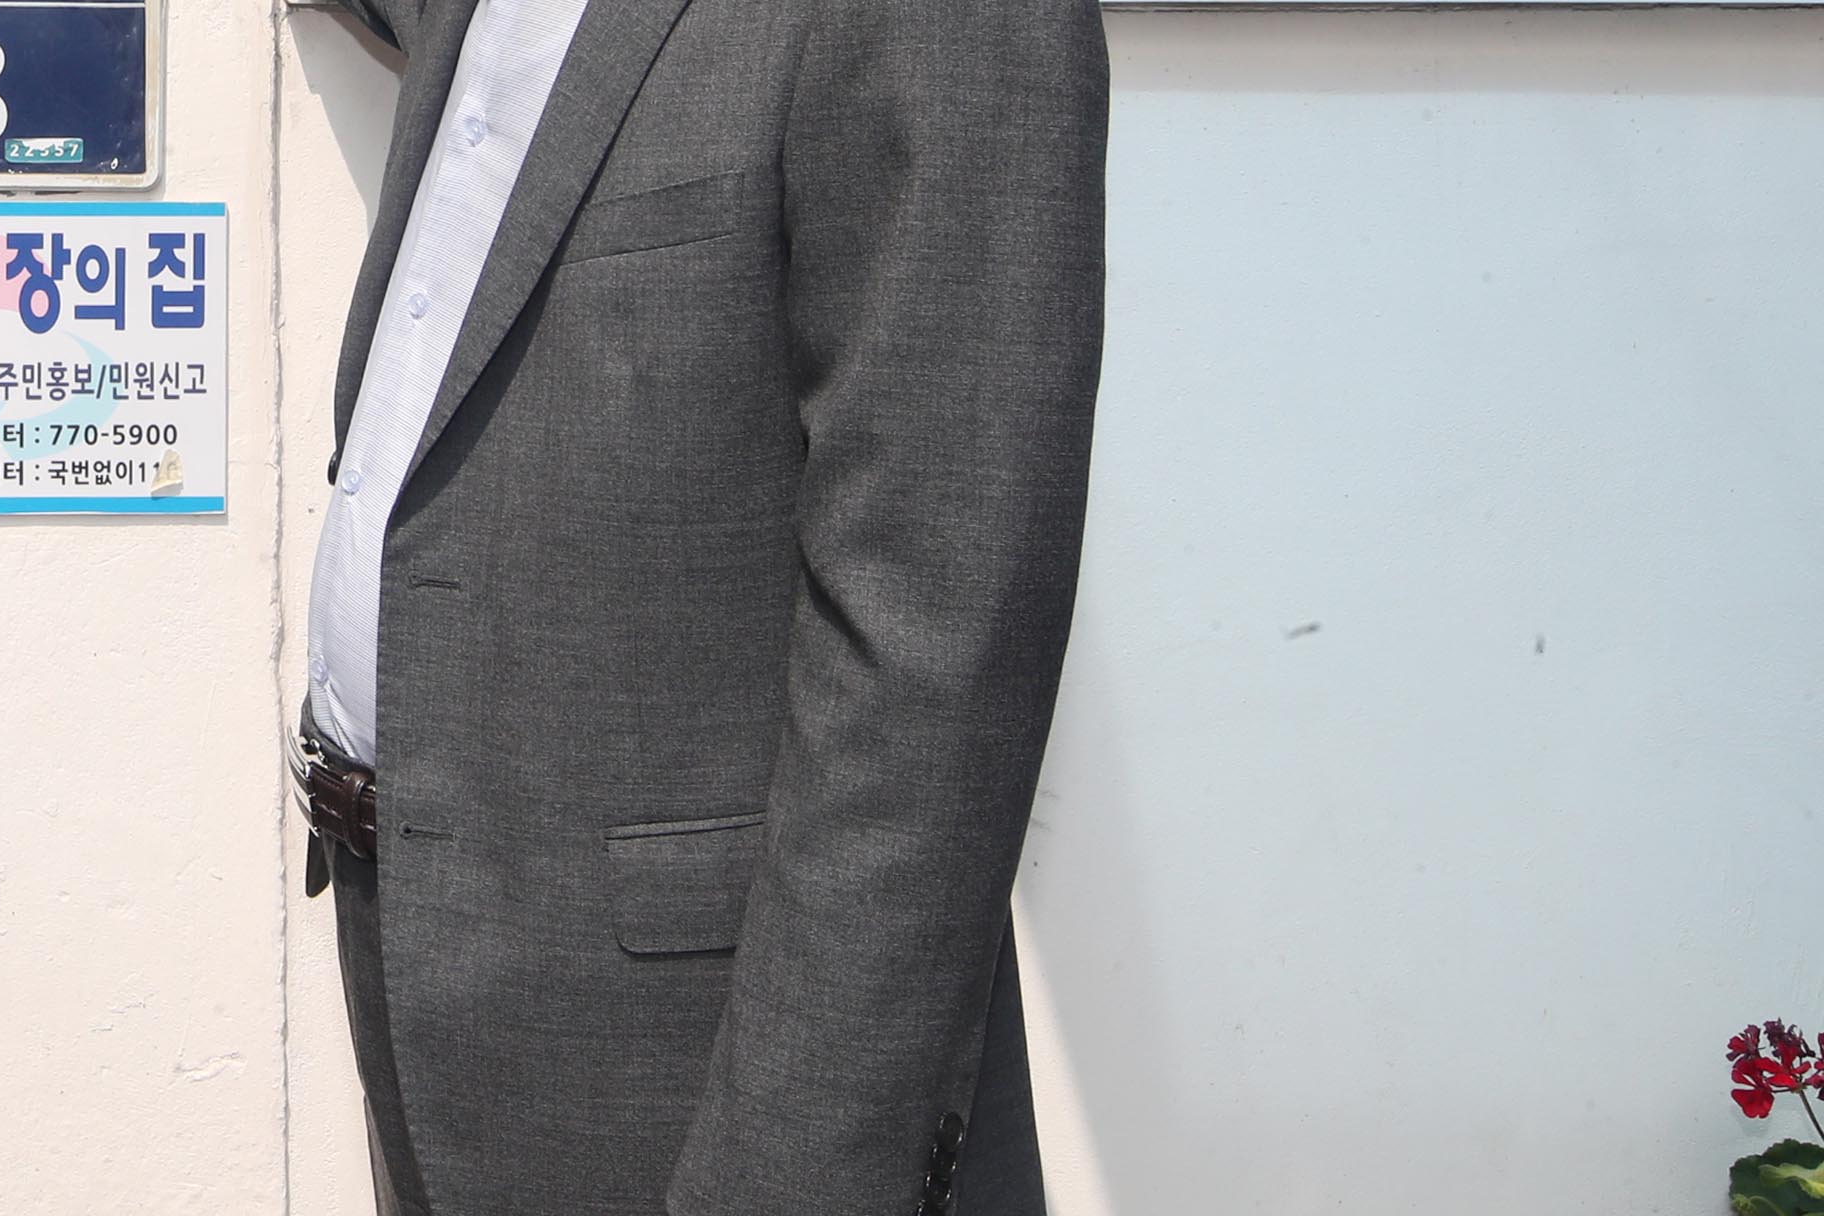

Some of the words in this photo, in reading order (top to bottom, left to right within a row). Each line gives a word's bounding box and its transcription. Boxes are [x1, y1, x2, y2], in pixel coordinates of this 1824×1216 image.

[147, 233, 206, 329] 집
[49, 424, 178, 446] 770-5900
[48, 460, 177, 486] 국번없이11
